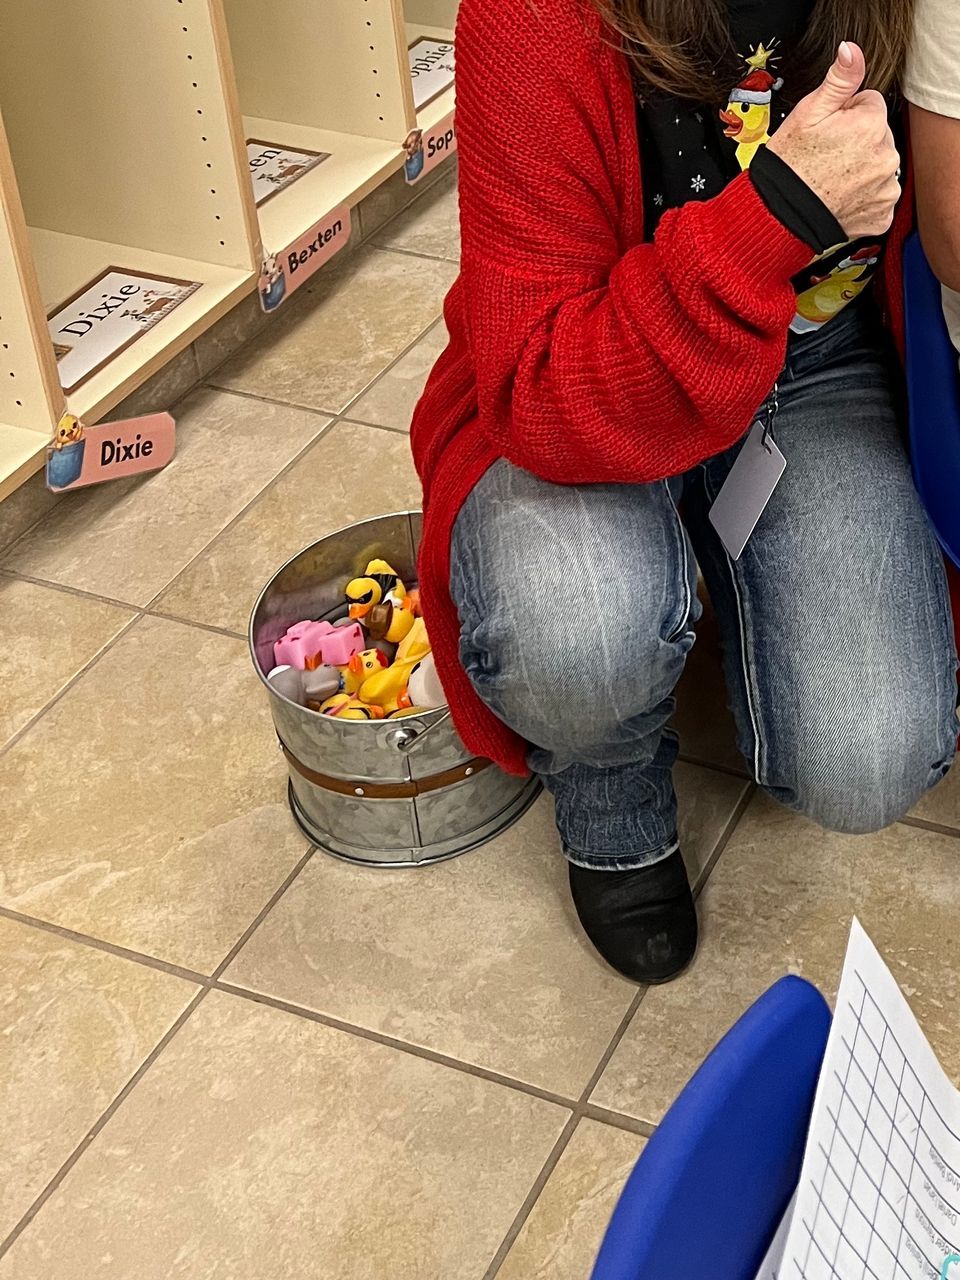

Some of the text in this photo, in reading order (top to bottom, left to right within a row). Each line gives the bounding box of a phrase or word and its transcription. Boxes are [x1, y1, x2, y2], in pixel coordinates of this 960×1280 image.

[288, 219, 342, 274] Bexten
[58, 283, 141, 338] Dixie
[100, 436, 153, 466] Dixie
